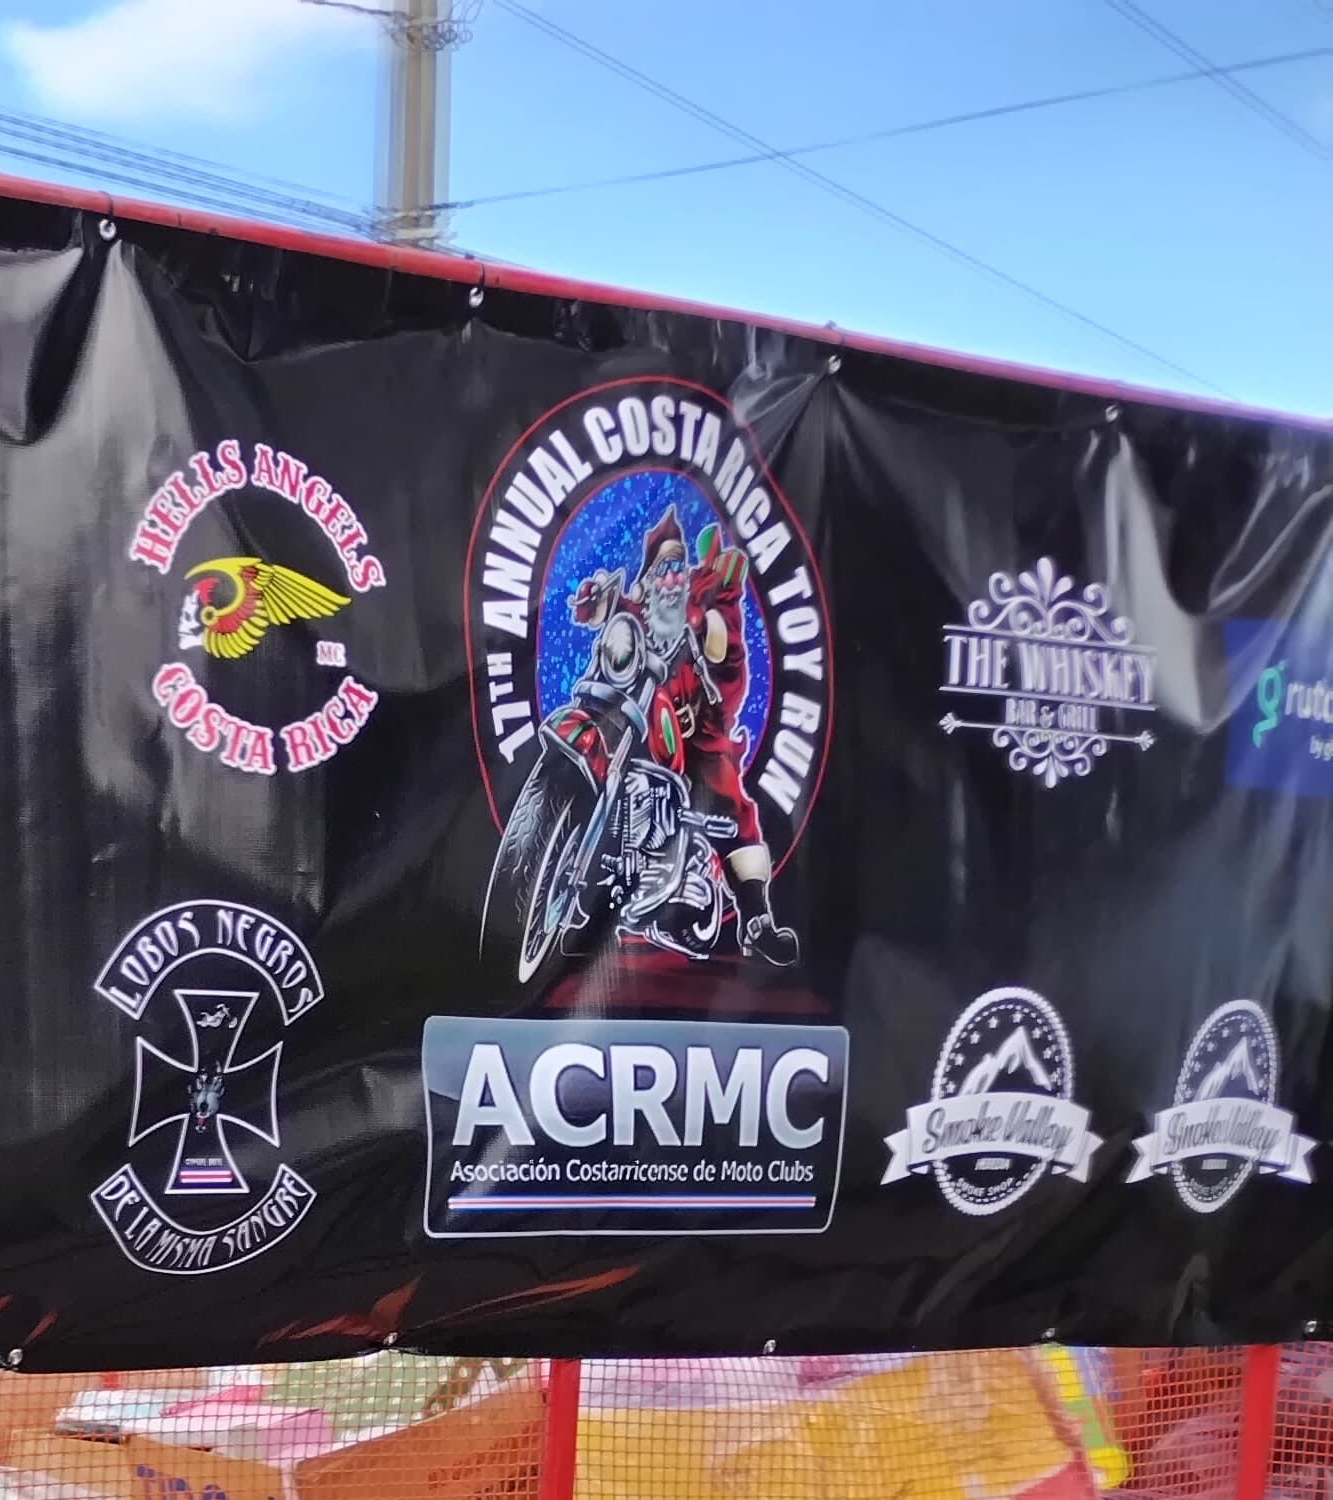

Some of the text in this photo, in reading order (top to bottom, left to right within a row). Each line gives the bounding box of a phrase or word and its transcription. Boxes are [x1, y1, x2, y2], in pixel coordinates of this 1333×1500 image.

[130, 440, 386, 592] HELLS ANGELS
[482, 396, 823, 815] 17TH ANNUAL COSTA RICA TOY RUN
[317, 641, 346, 667] MC
[943, 635, 1156, 703] THE WHISKEY
[153, 662, 378, 775] COSTA RICA
[1005, 698, 1037, 726] BAR
[1039, 705, 1054, 728] &
[109, 909, 313, 1013] LOBOS NEGROS
[451, 1043, 829, 1149] ACRMC
[923, 1101, 1072, 1160] Smoke Valley
[1165, 1106, 1226, 1155] Smoke
[451, 1157, 814, 1183] Asociación Costarricense de Moto Clubs
[101, 1175, 307, 1268] DE LA MISMA SANGRE
